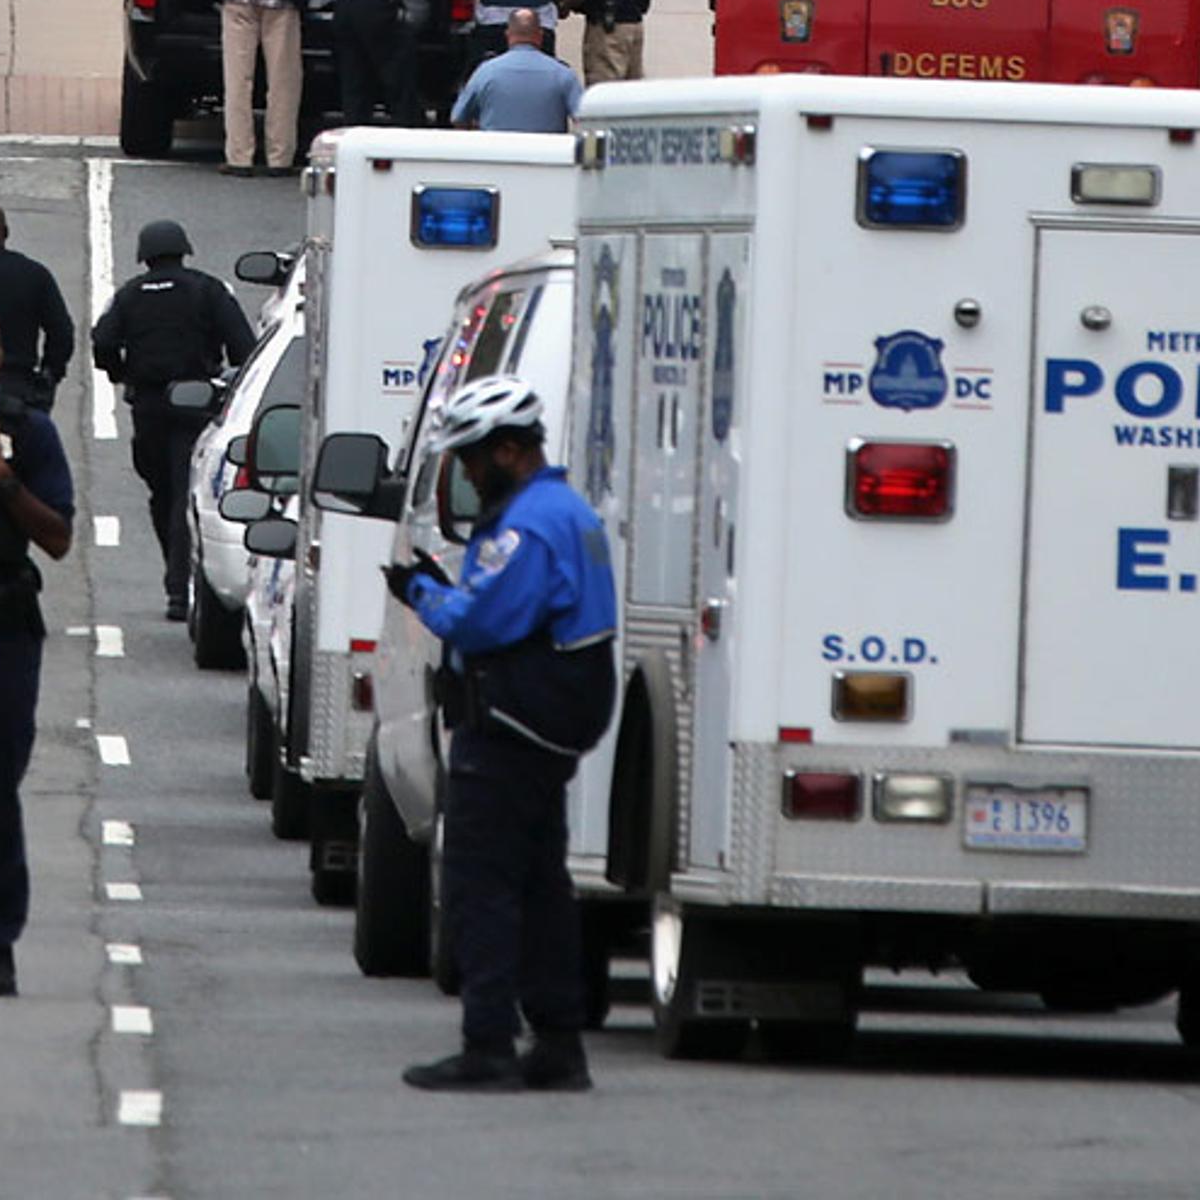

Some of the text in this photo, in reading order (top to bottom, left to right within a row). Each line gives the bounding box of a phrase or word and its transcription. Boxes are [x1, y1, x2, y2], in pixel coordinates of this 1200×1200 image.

[893, 52, 1027, 80] DCFEMS
[642, 294, 700, 359] POLICE
[382, 368, 416, 387] MP
[823, 372, 993, 400] MP DC
[1043, 357, 1200, 420] PO
[820, 633, 939, 665] S.O.D.
